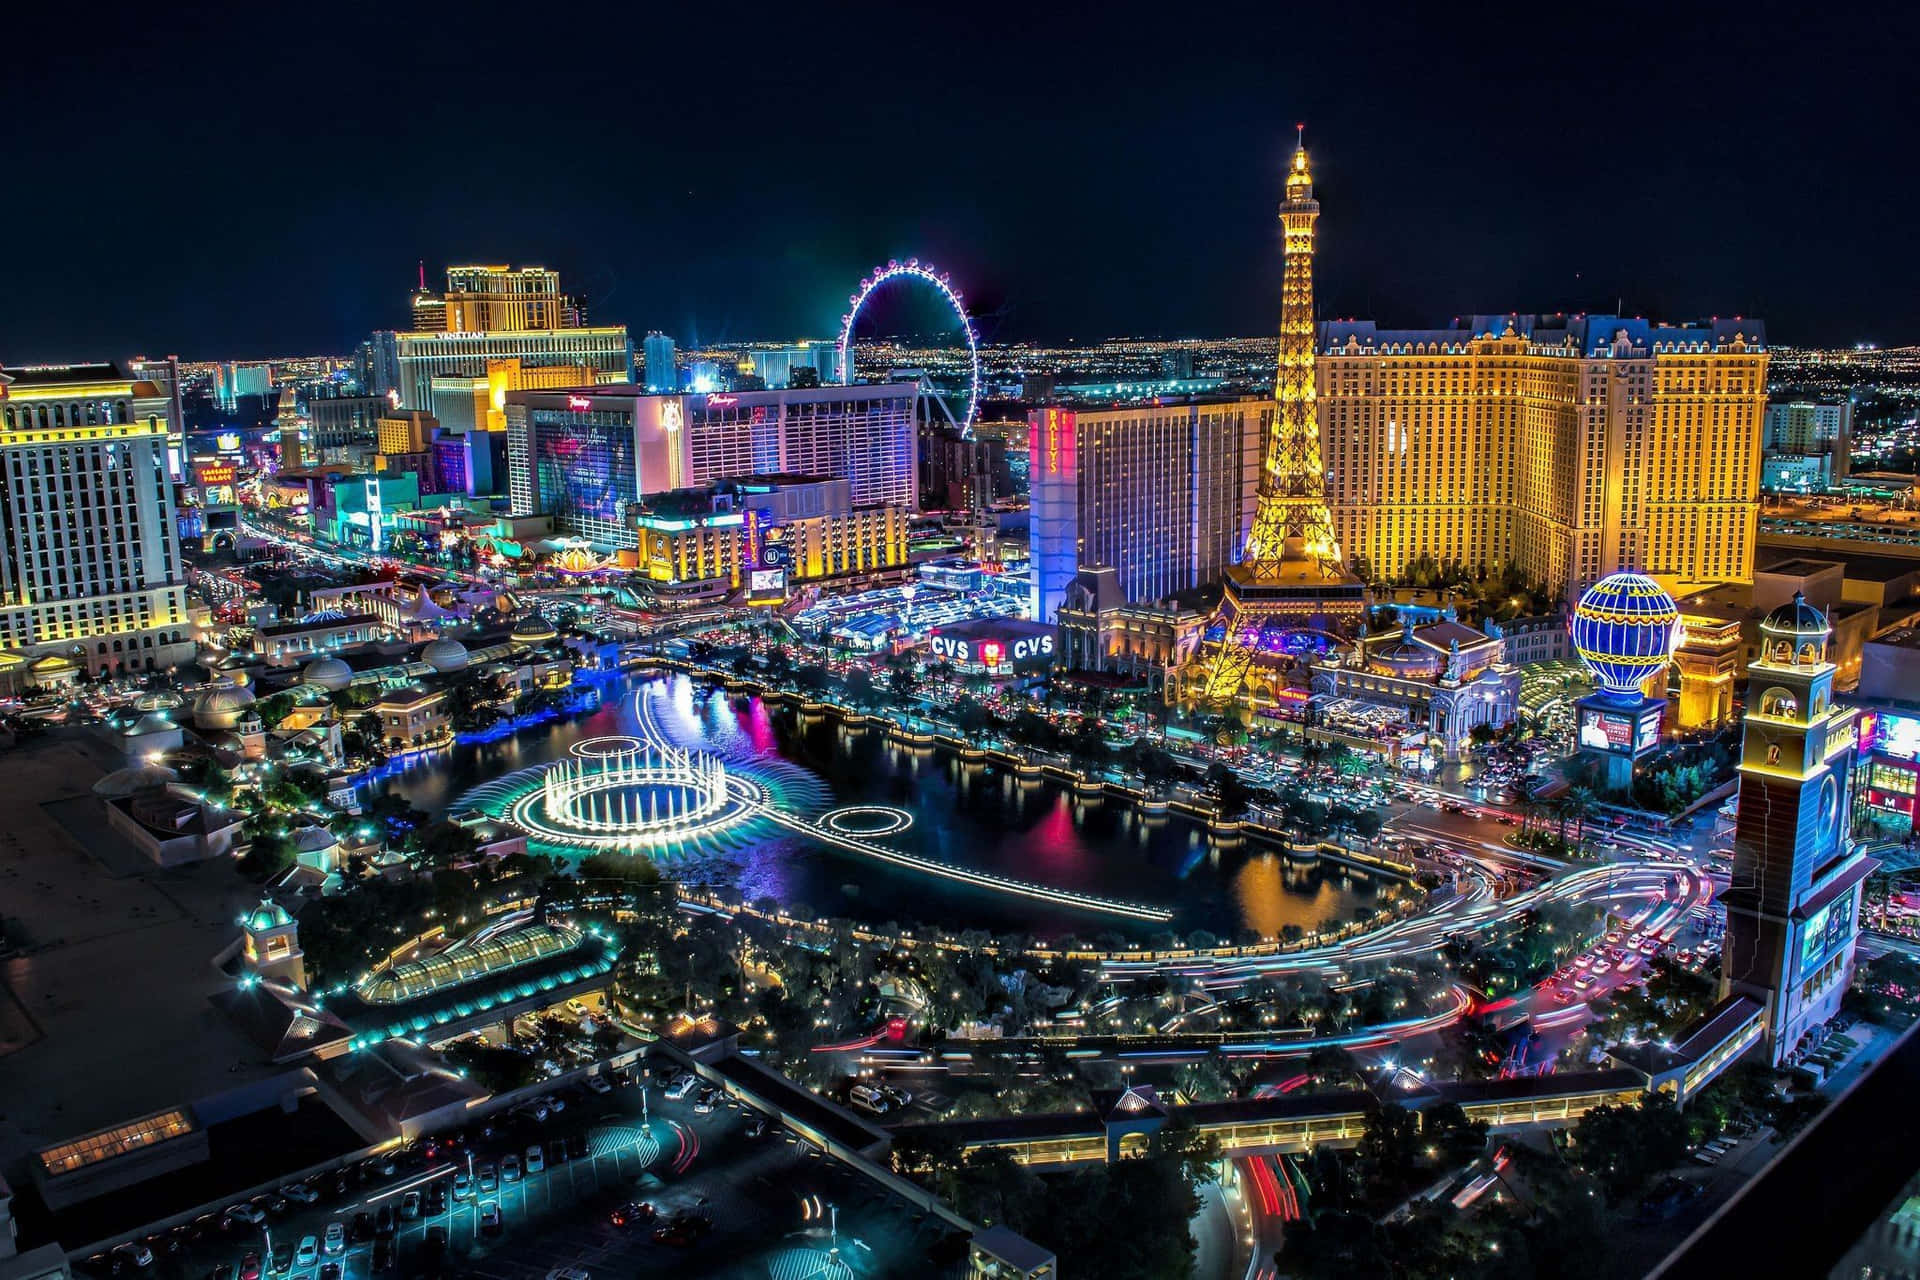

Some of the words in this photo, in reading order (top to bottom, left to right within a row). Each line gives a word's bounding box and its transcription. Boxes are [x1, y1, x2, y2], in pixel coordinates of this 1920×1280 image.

[438, 331, 484, 340] VENETIAN
[202, 467, 232, 475] CAESARS
[204, 474, 232, 482] PALACE
[931, 636, 969, 660] CVS
[1014, 635, 1053, 659] CVS
